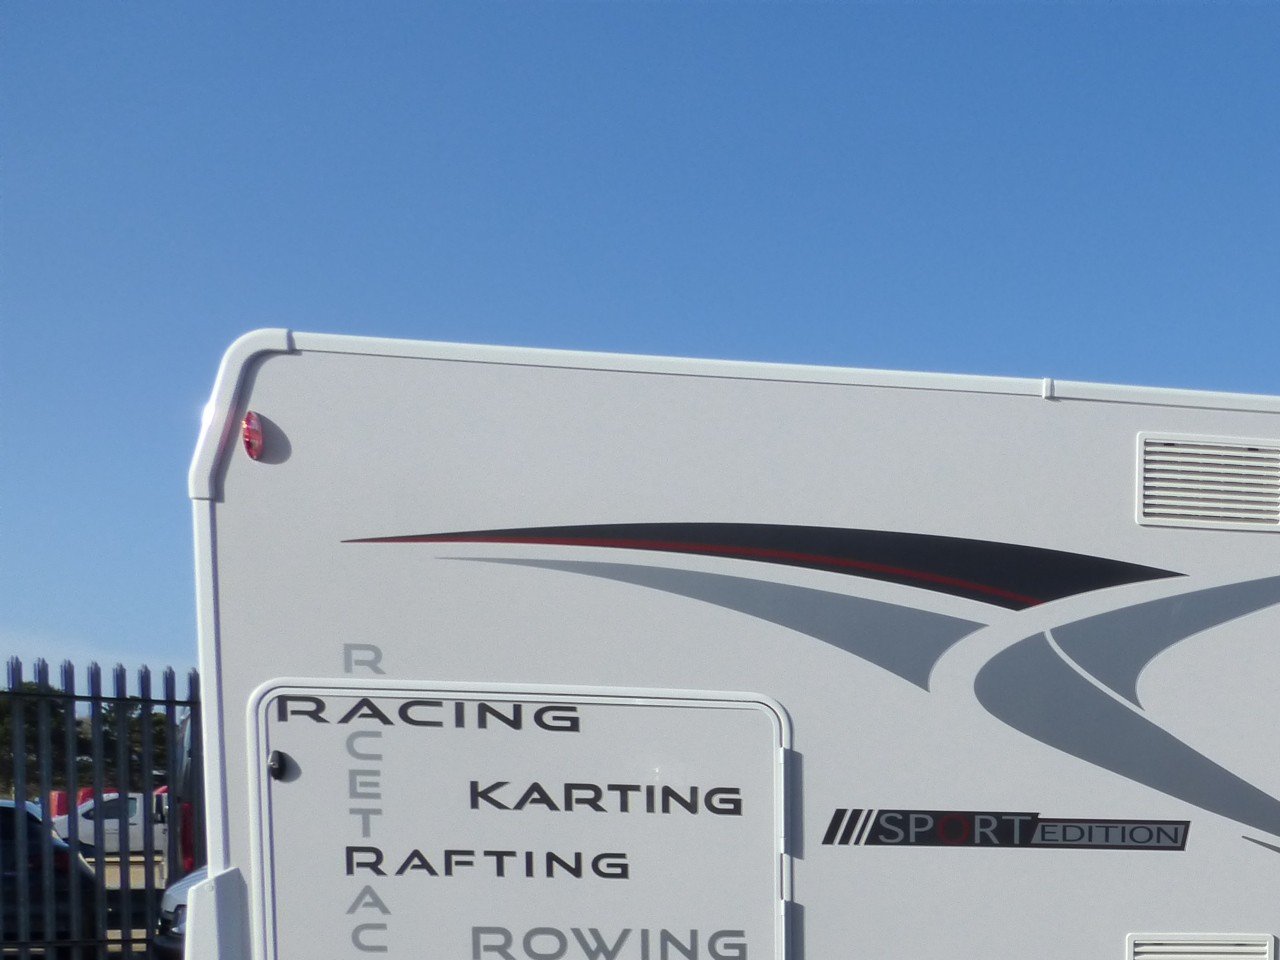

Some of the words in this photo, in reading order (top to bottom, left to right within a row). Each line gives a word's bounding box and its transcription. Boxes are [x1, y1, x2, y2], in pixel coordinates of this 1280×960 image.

[276, 696, 581, 733] RACING
[469, 780, 743, 816] KARTING
[878, 811, 1032, 844] SPORT
[1040, 823, 1180, 844] EDITION
[345, 846, 630, 879] RAFTING
